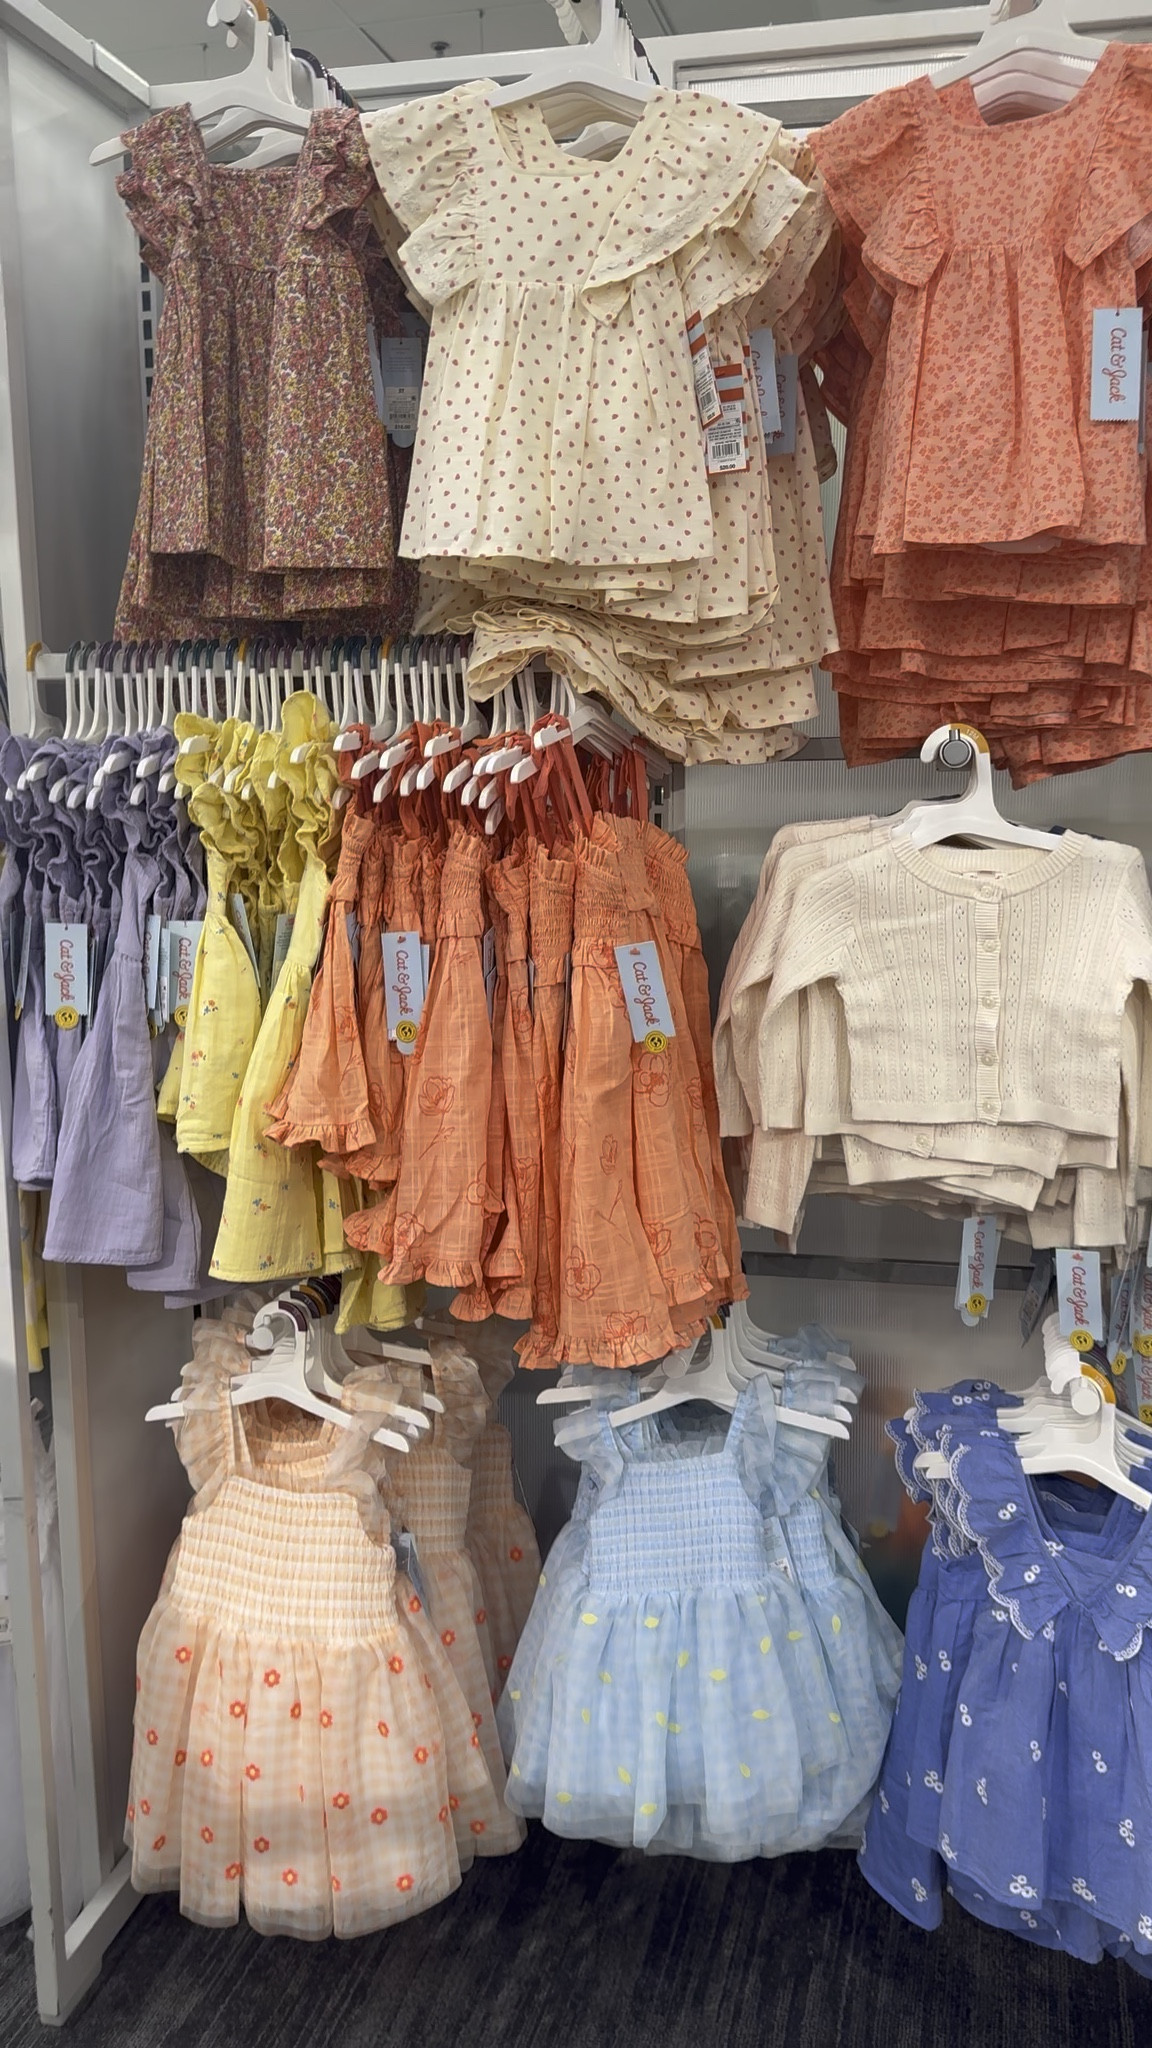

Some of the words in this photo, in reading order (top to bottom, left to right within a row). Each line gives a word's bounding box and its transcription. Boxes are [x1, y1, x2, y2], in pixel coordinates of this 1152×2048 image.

[1110, 327, 1128, 352] Cat
[1110, 353, 1127, 368] &
[1101, 367, 1128, 404] Jack
[59, 939, 74, 960] Cat
[178, 936, 192, 958] Cat
[60, 960, 74, 974] &
[178, 958, 191, 972] &
[395, 949, 409, 972] Cat
[397, 972, 410, 986] &
[632, 961, 649, 984] Cat
[53, 972, 76, 1003] Jack
[172, 971, 193, 1000] Jack
[637, 984, 652, 997] &
[391, 985, 414, 1016] Jack
[633, 997, 661, 1027] Jack
[973, 1230, 986, 1250] Cat
[973, 1250, 985, 1263] &
[967, 1262, 985, 1290] Jack
[1071, 1266, 1087, 1286] Cat
[1072, 1287, 1088, 1300] &
[1066, 1298, 1090, 1326] Jack
